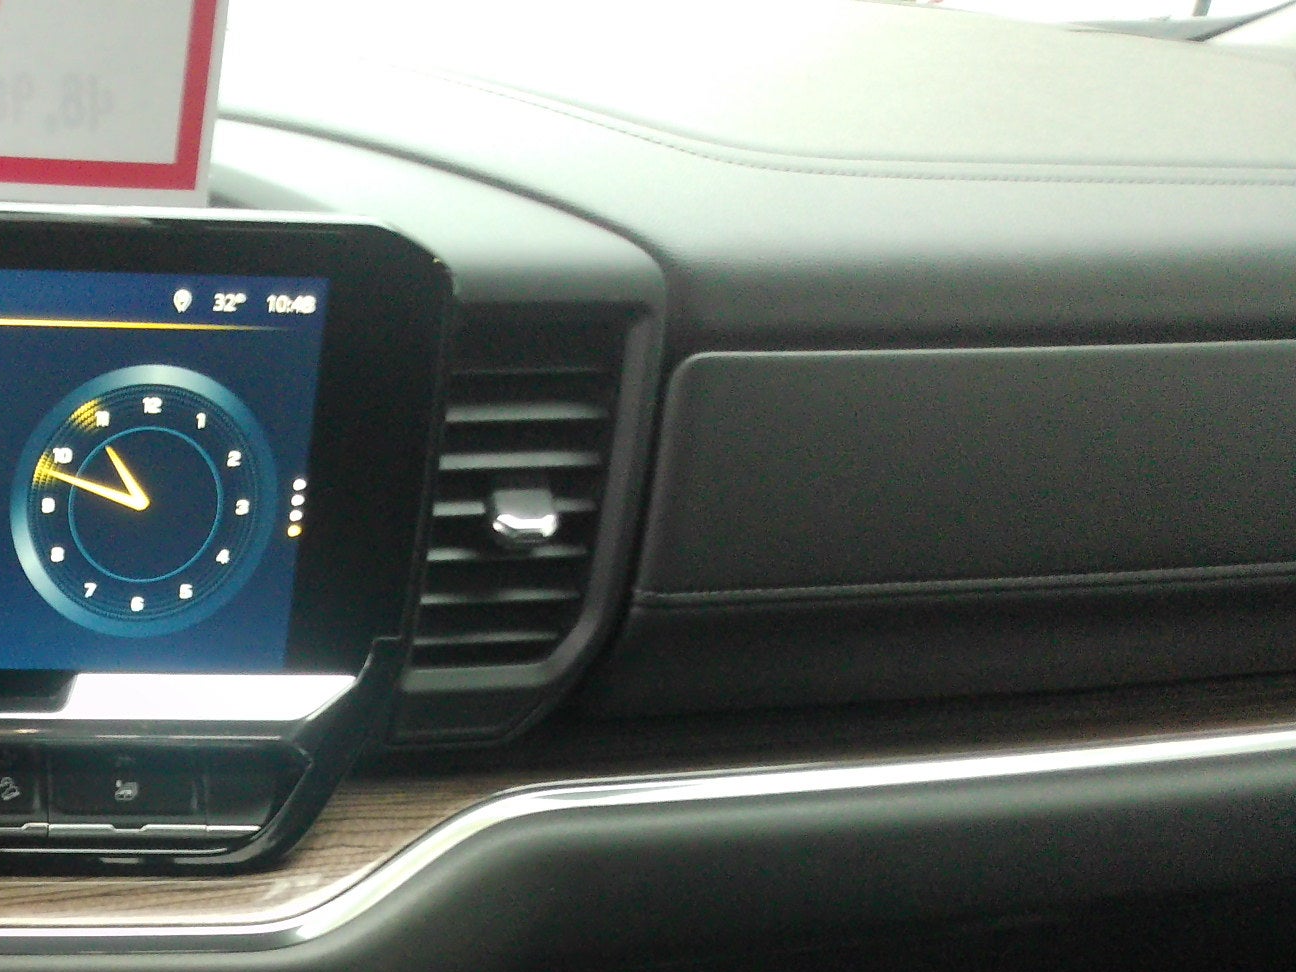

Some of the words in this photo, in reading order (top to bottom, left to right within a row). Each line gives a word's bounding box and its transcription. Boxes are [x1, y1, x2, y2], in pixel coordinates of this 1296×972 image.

[142, 397, 163, 414] 12
[195, 412, 206, 429] 1
[52, 447, 73, 464] 10
[227, 450, 242, 468] 2
[235, 499, 250, 516] 3
[215, 548, 231, 564] 4
[83, 582, 98, 598] 7
[179, 583, 193, 599] 5
[129, 596, 145, 612] 6
